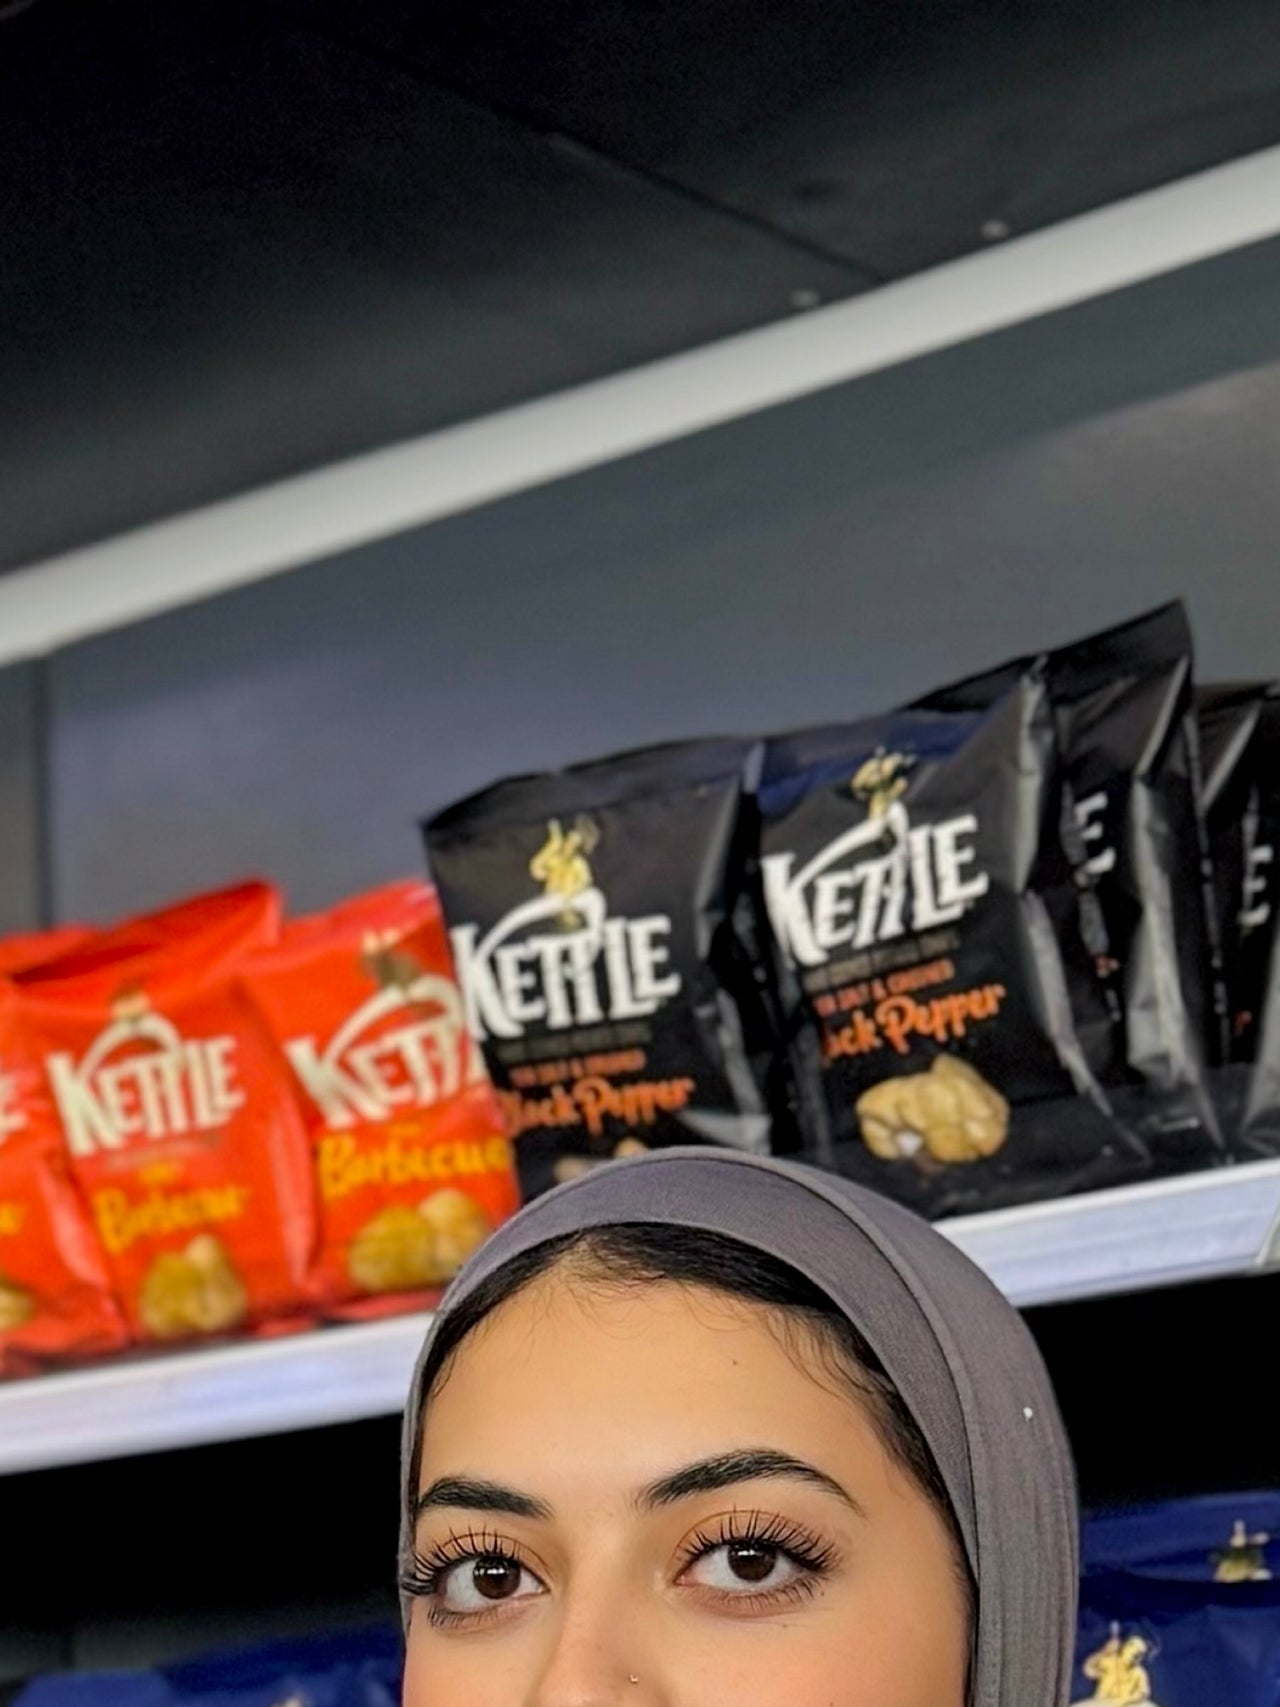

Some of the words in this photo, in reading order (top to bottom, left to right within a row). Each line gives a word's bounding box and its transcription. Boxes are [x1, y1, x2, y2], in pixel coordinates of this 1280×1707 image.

[761, 800, 989, 969] KETTLE
[449, 887, 682, 1041] KETTLE
[45, 1010, 245, 1157] KETTLE
